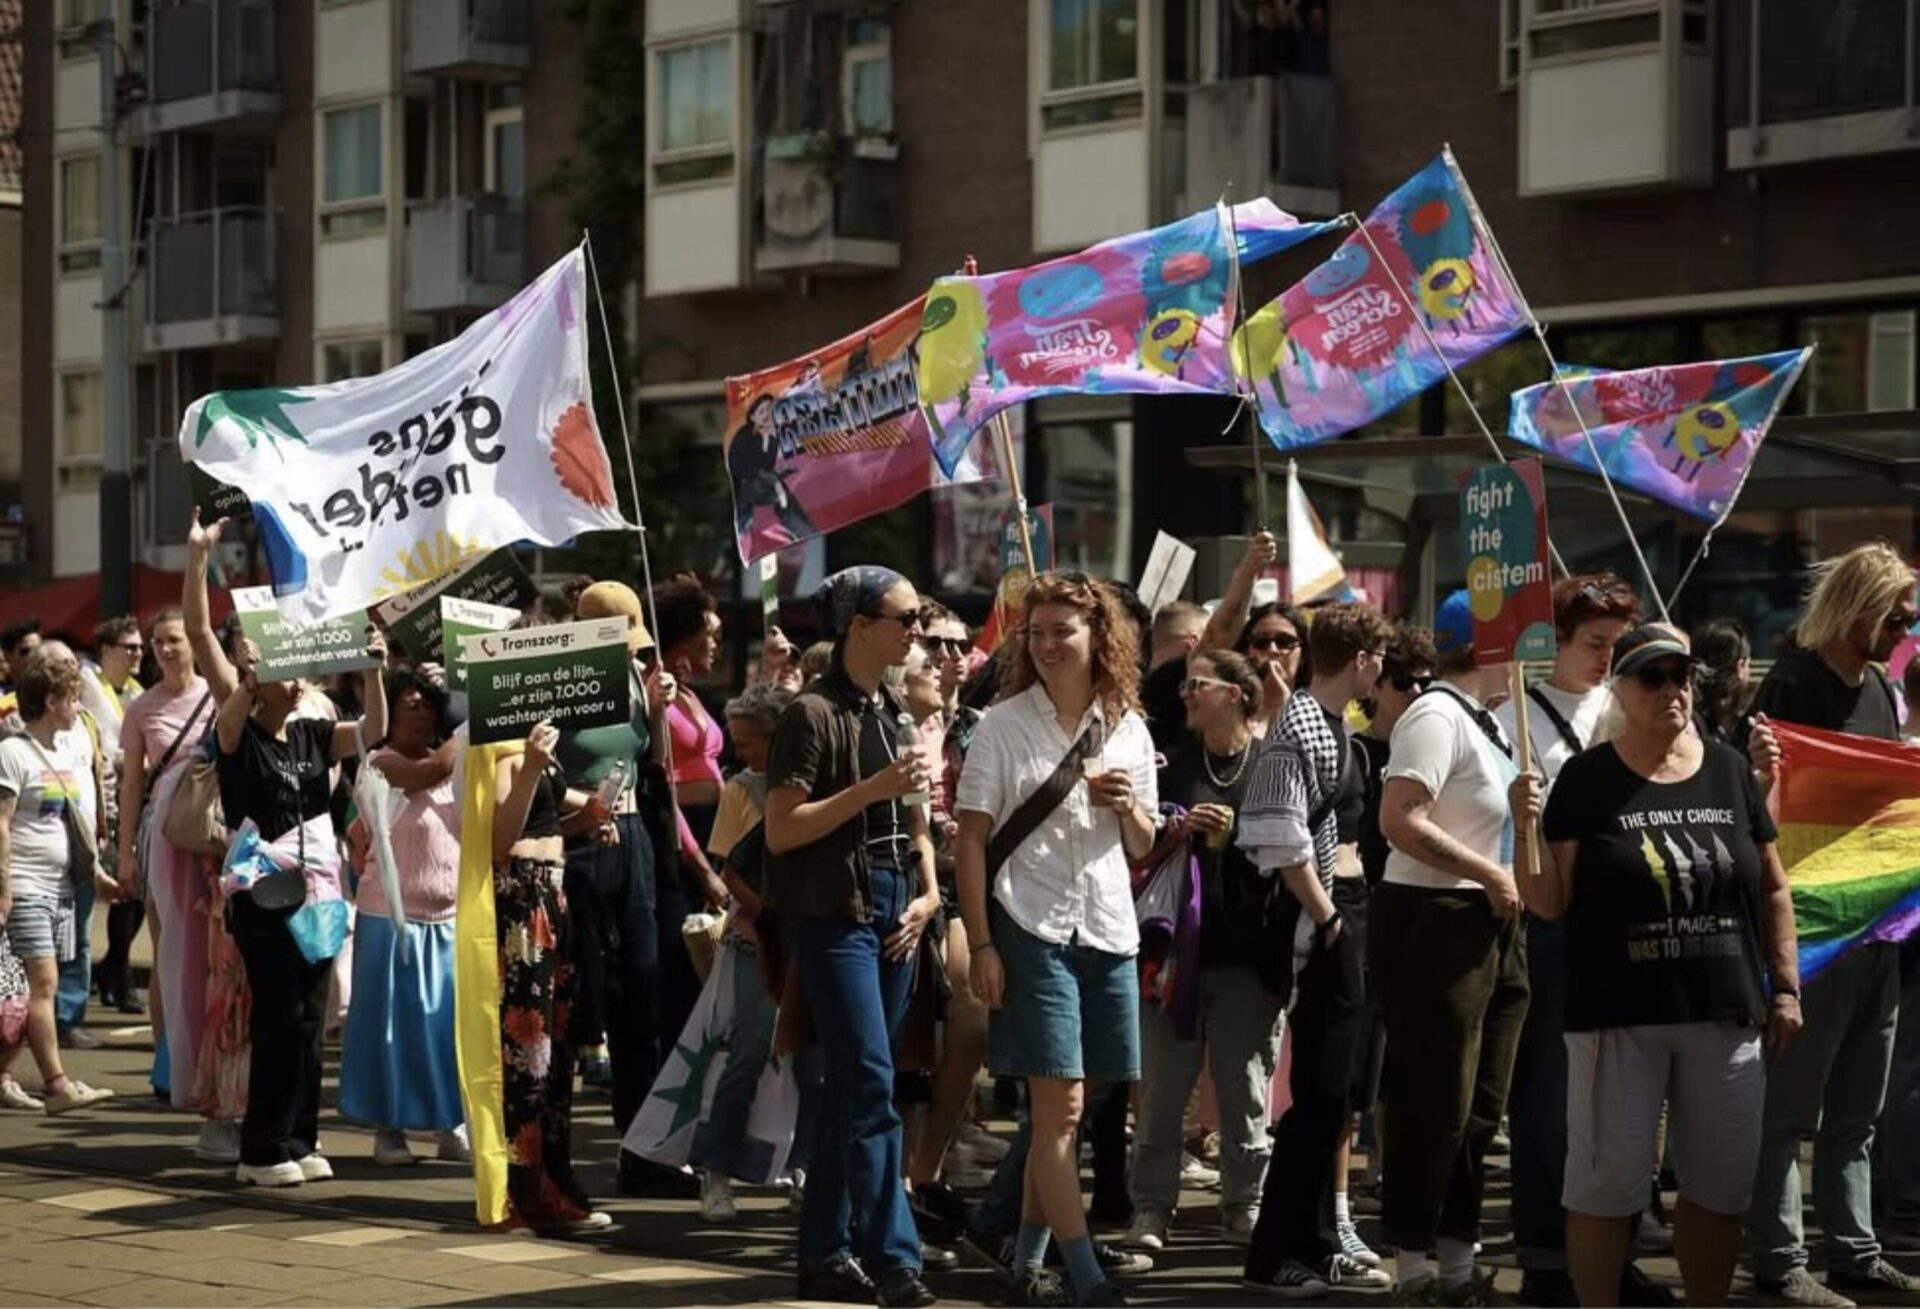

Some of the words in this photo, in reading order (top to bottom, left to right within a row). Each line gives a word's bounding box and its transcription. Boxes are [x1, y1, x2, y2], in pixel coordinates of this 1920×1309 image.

[1466, 482, 1514, 519] fight
[1470, 524, 1502, 553] the
[1473, 561, 1543, 591] cistem
[335, 647, 359, 660] voor
[501, 632, 576, 652] Transzorg:
[492, 672, 522, 690] Blijf
[524, 670, 551, 683] aan
[553, 666, 571, 681] de
[528, 690, 554, 706] zijn
[486, 706, 572, 728] wachtenden
[573, 701, 604, 715] voor
[607, 700, 615, 711] u
[1618, 812, 1648, 831] THE
[1648, 809, 1683, 827] ONLY
[1687, 808, 1735, 825] CHOICE
[1677, 915, 1717, 935] MADE
[1628, 940, 1660, 962] WAS
[1662, 937, 1681, 959] TO
